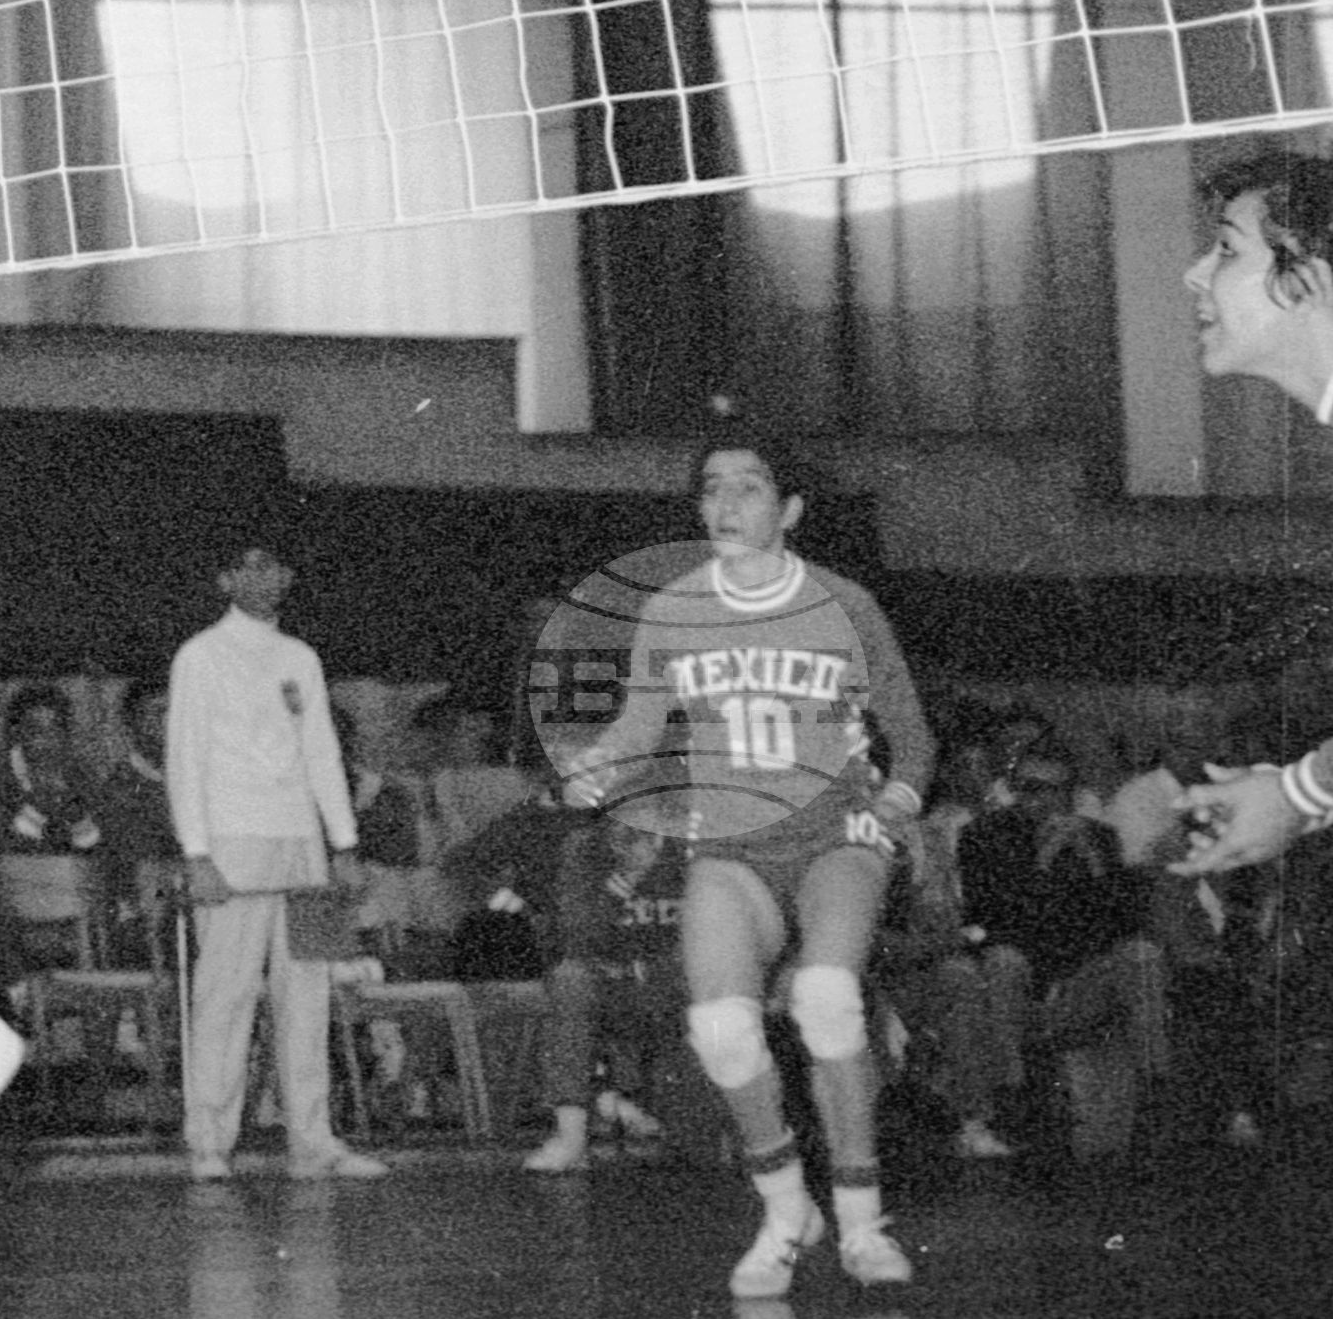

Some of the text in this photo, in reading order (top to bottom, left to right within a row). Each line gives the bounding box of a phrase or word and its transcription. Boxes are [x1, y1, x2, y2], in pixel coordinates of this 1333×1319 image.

[670, 646, 846, 703] MEXICO
[719, 695, 796, 770] 10
[844, 810, 881, 846] 10
